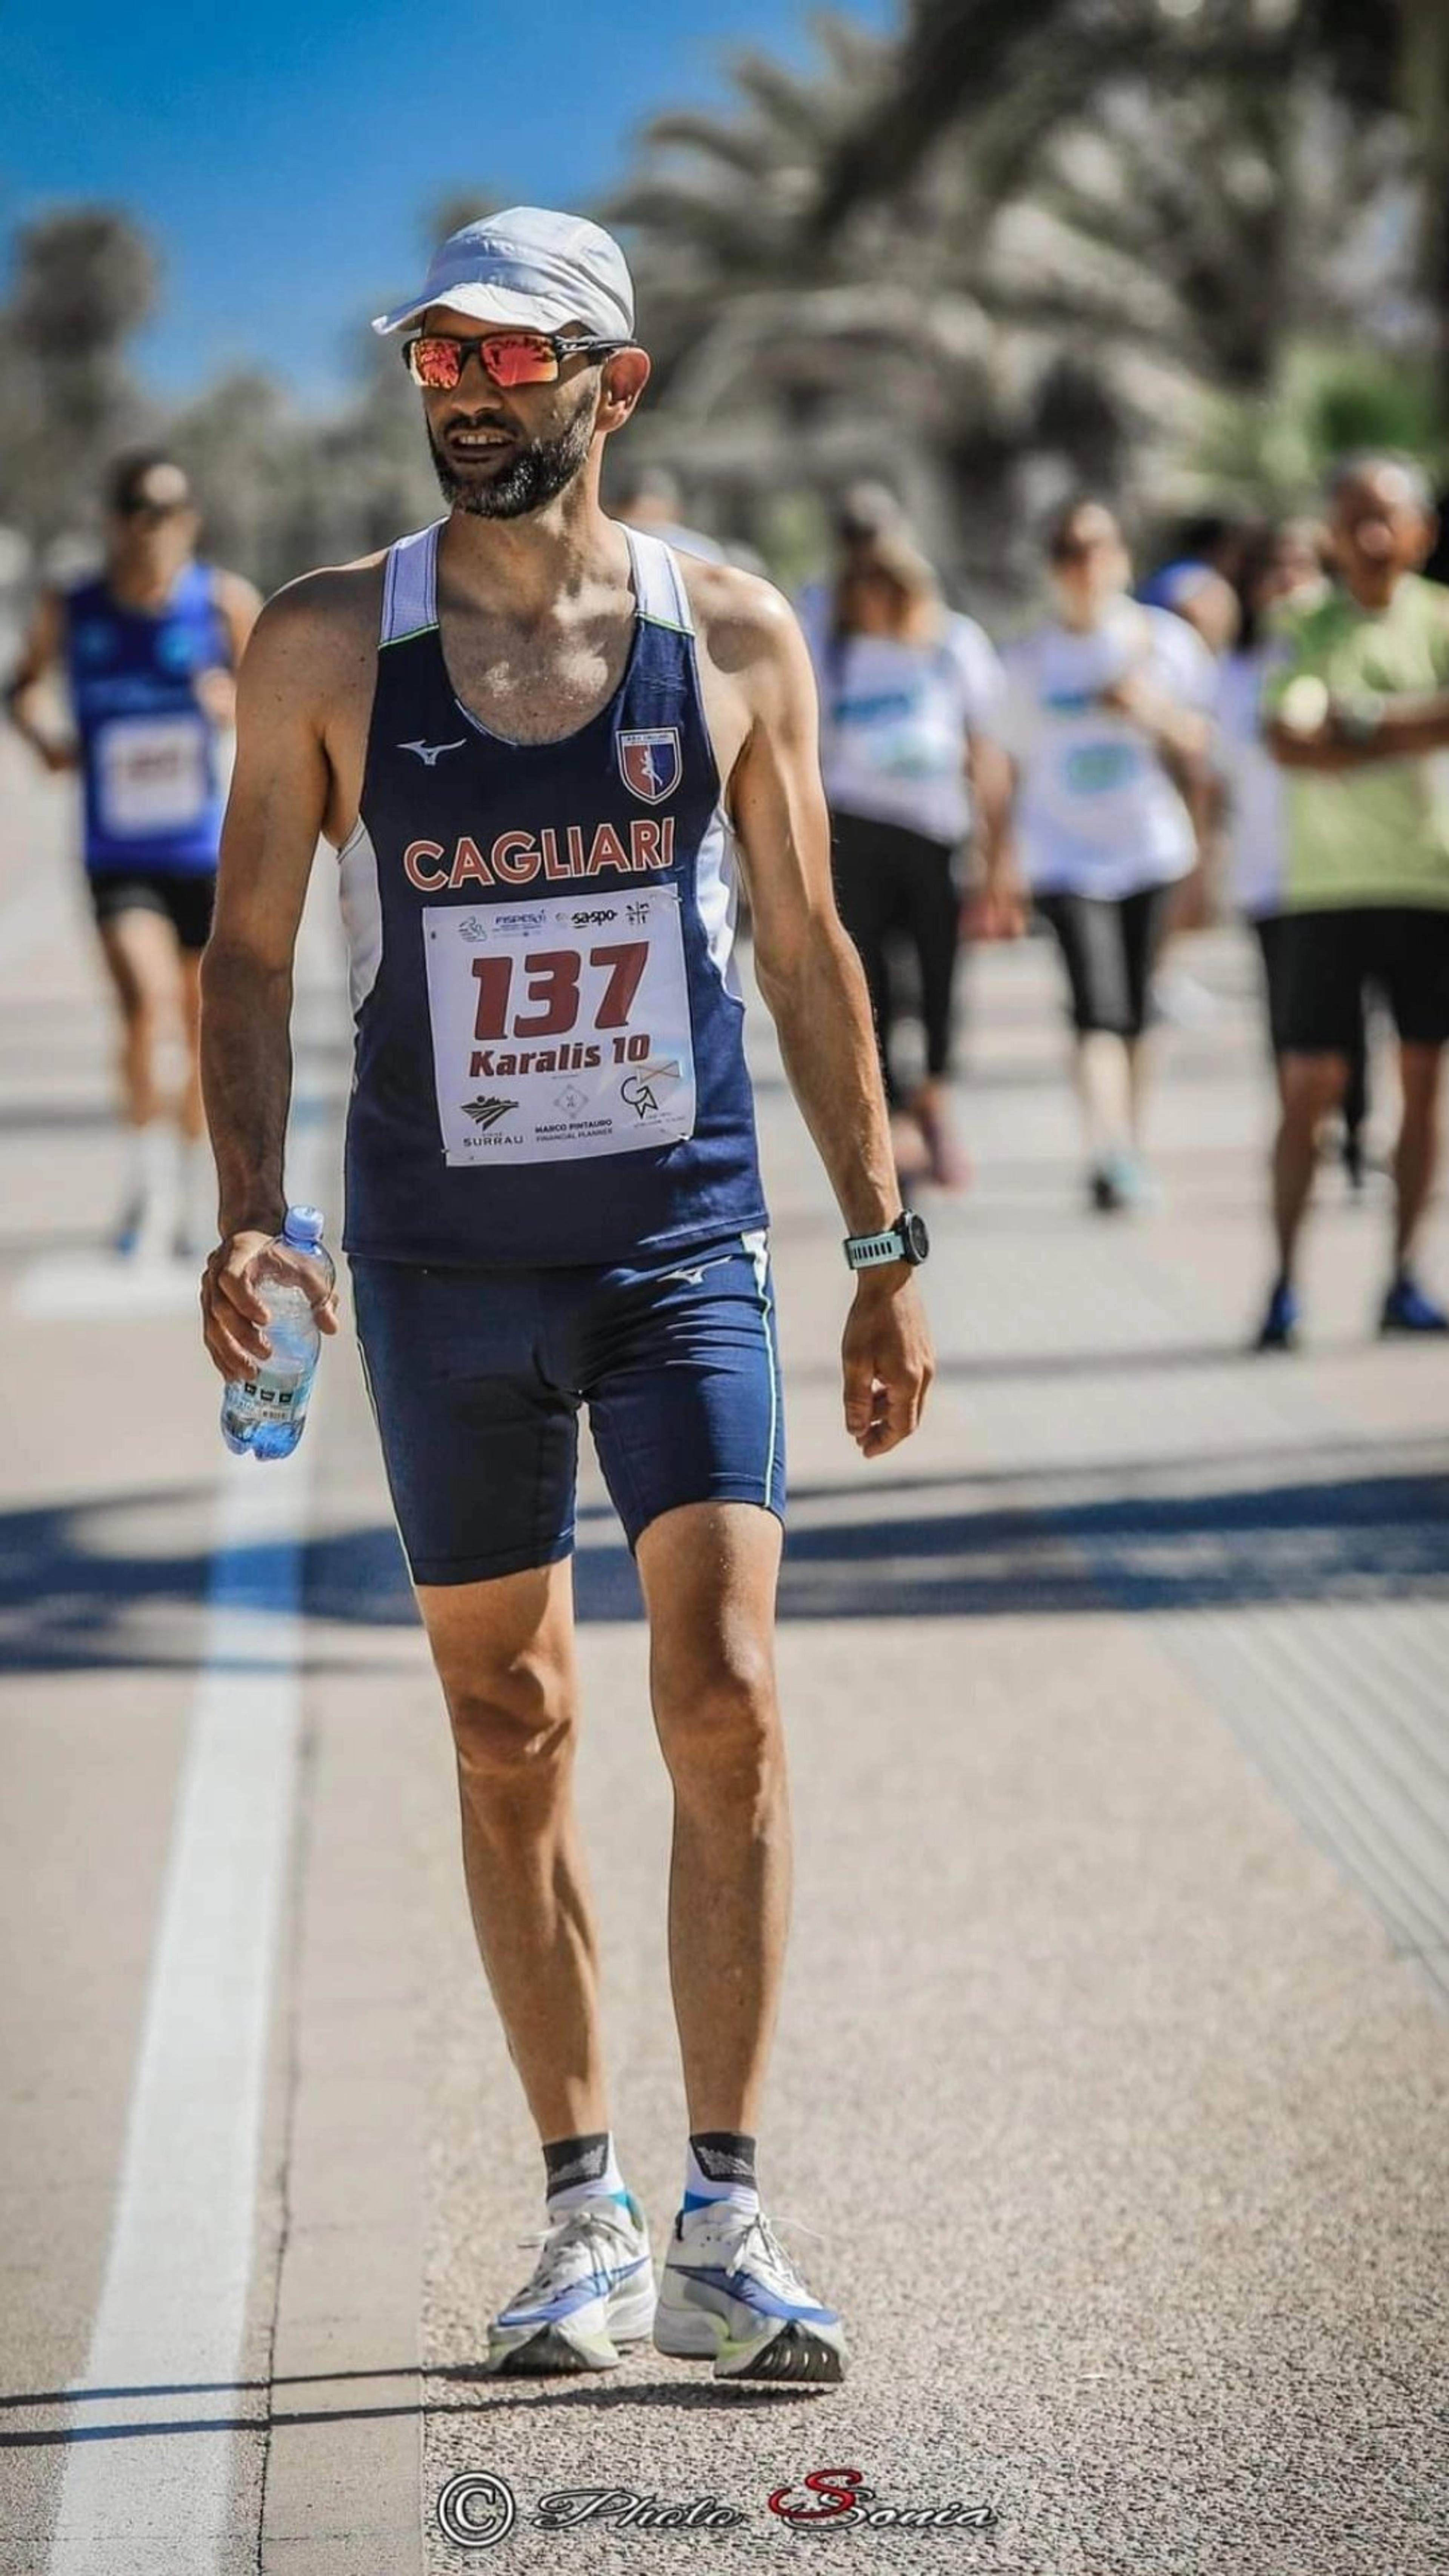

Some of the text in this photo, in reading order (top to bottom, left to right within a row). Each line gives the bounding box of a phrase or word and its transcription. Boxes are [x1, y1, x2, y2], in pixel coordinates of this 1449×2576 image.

[403, 817, 675, 892] CAGLIARI
[472, 941, 650, 1041] 137
[469, 1034, 651, 1077] Karalis 10
[463, 1135, 523, 1147] SURRAU
